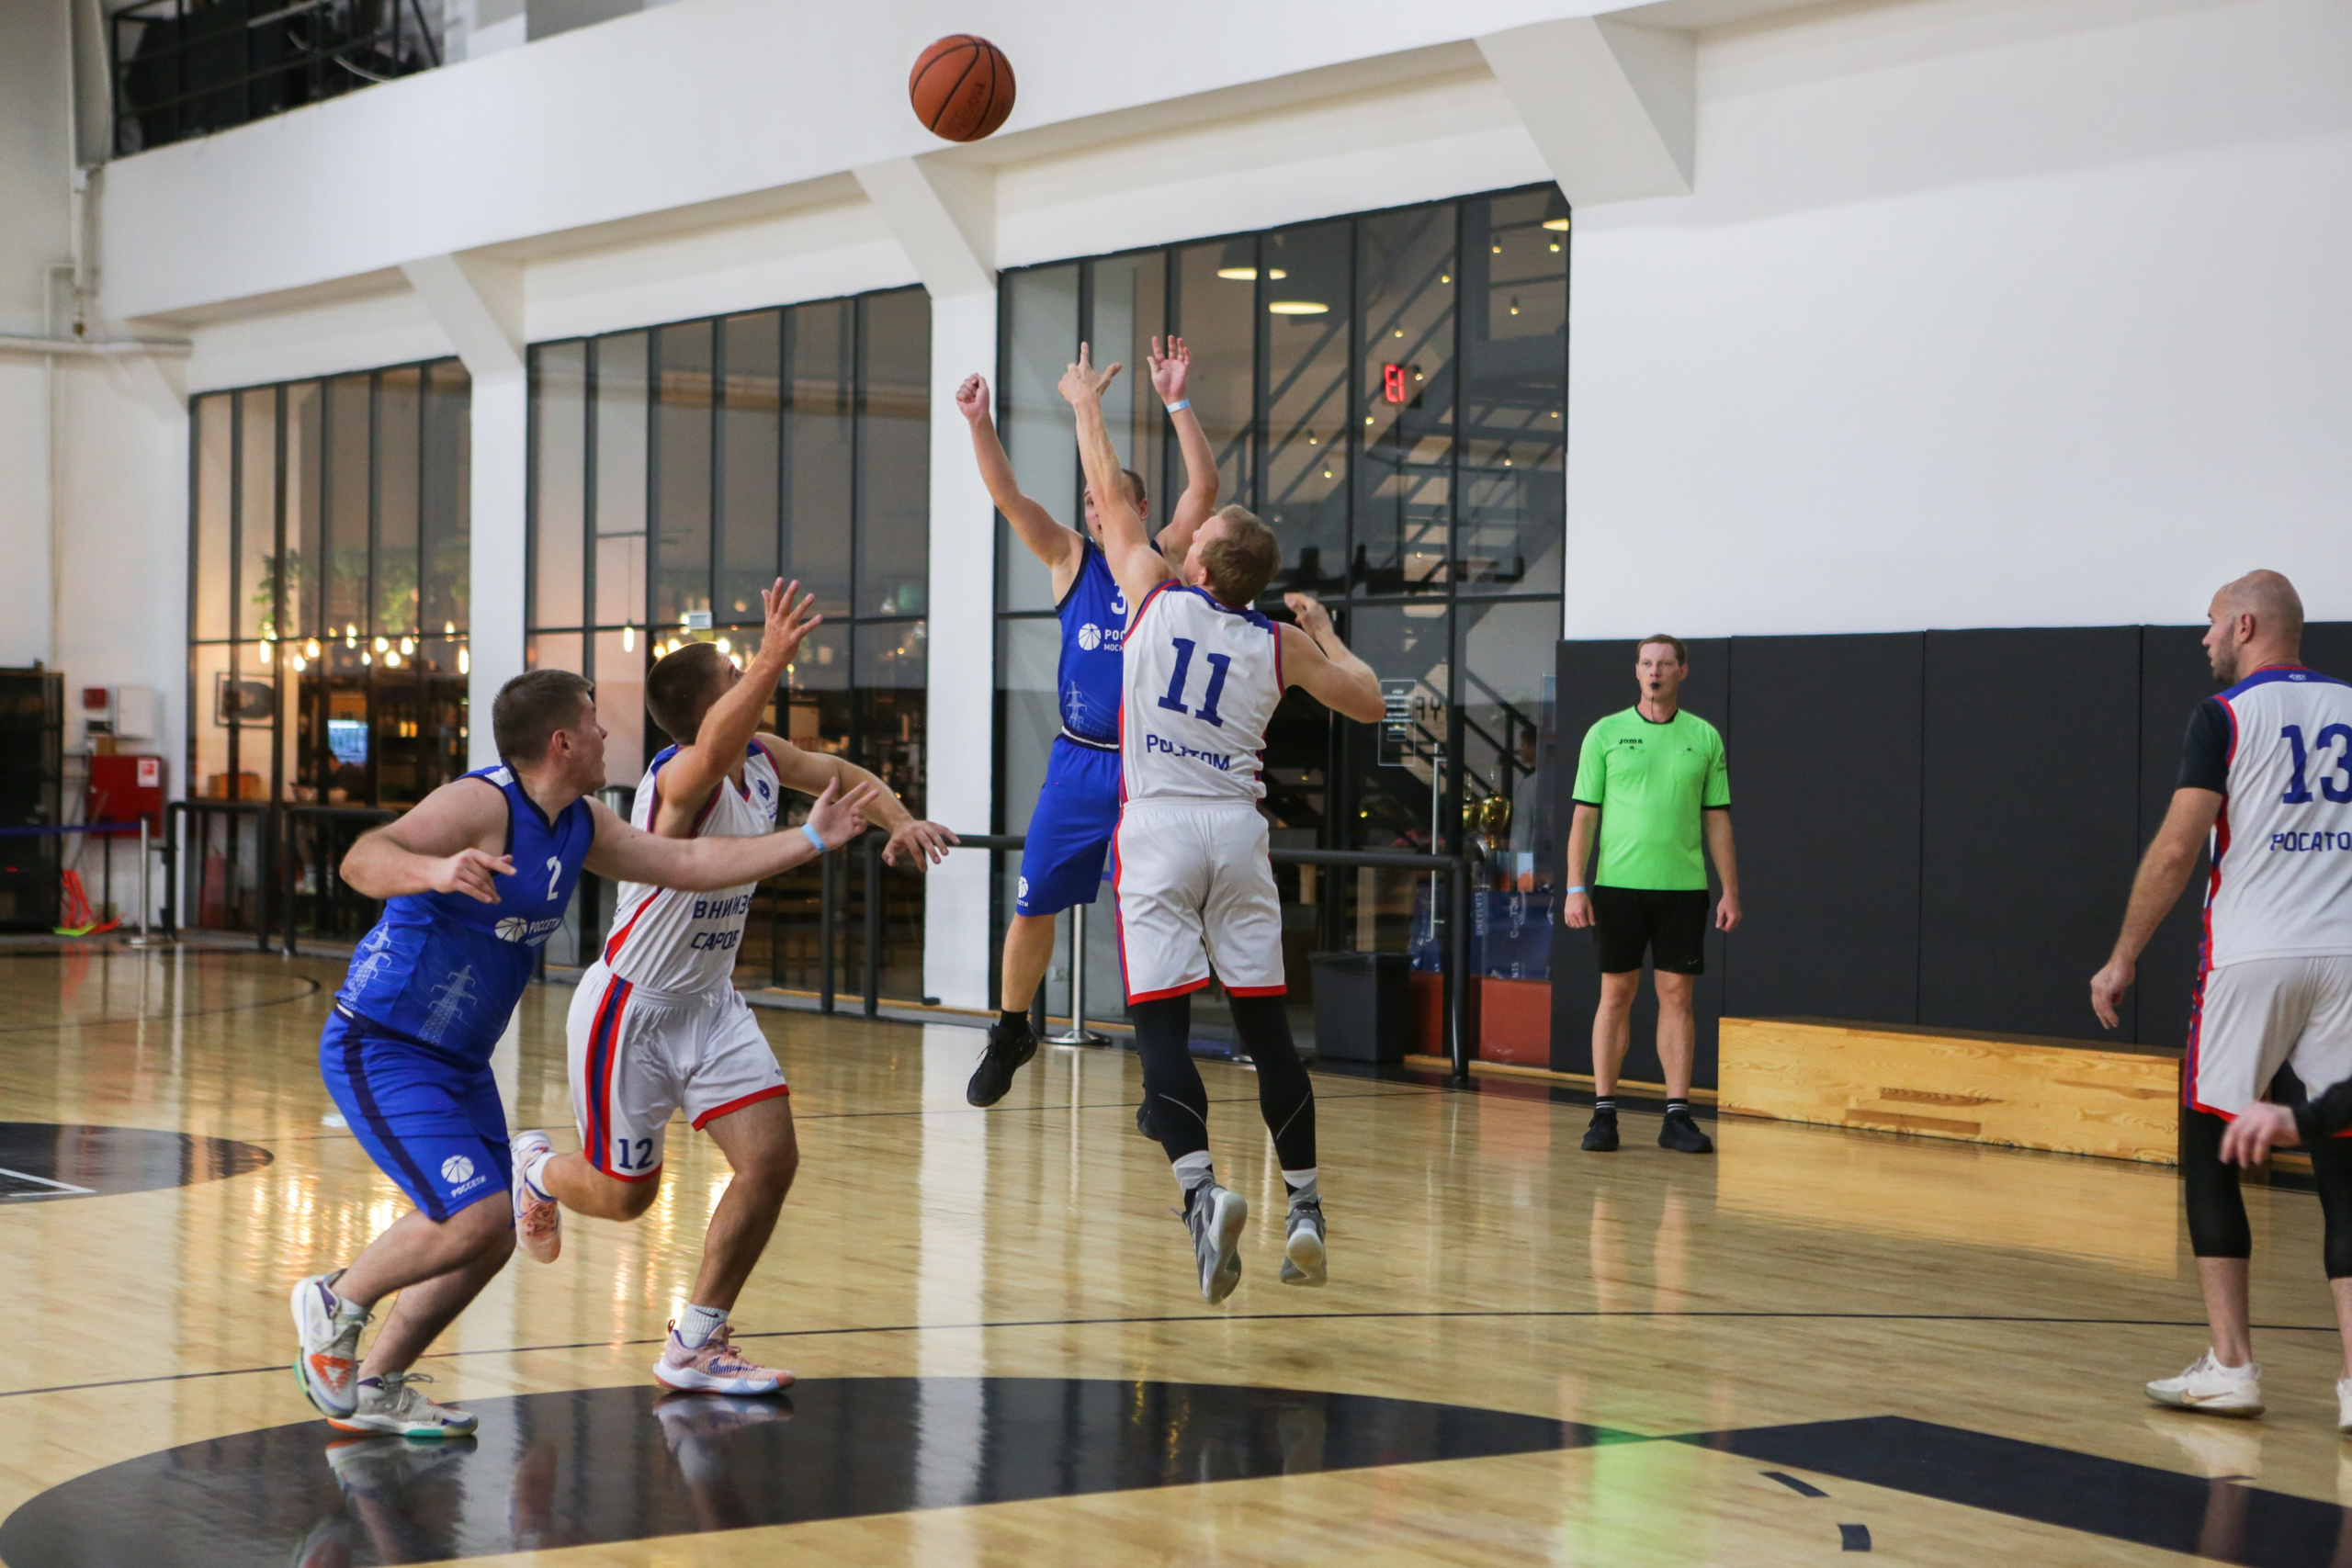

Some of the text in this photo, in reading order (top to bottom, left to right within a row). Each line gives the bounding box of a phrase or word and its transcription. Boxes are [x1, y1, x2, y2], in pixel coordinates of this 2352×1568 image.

[1158, 637, 1231, 728] 11
[2281, 723, 2352, 804] 13
[2270, 831, 2352, 852] РОСАТО
[547, 855, 561, 901] 2
[618, 1137, 653, 1170] 12
